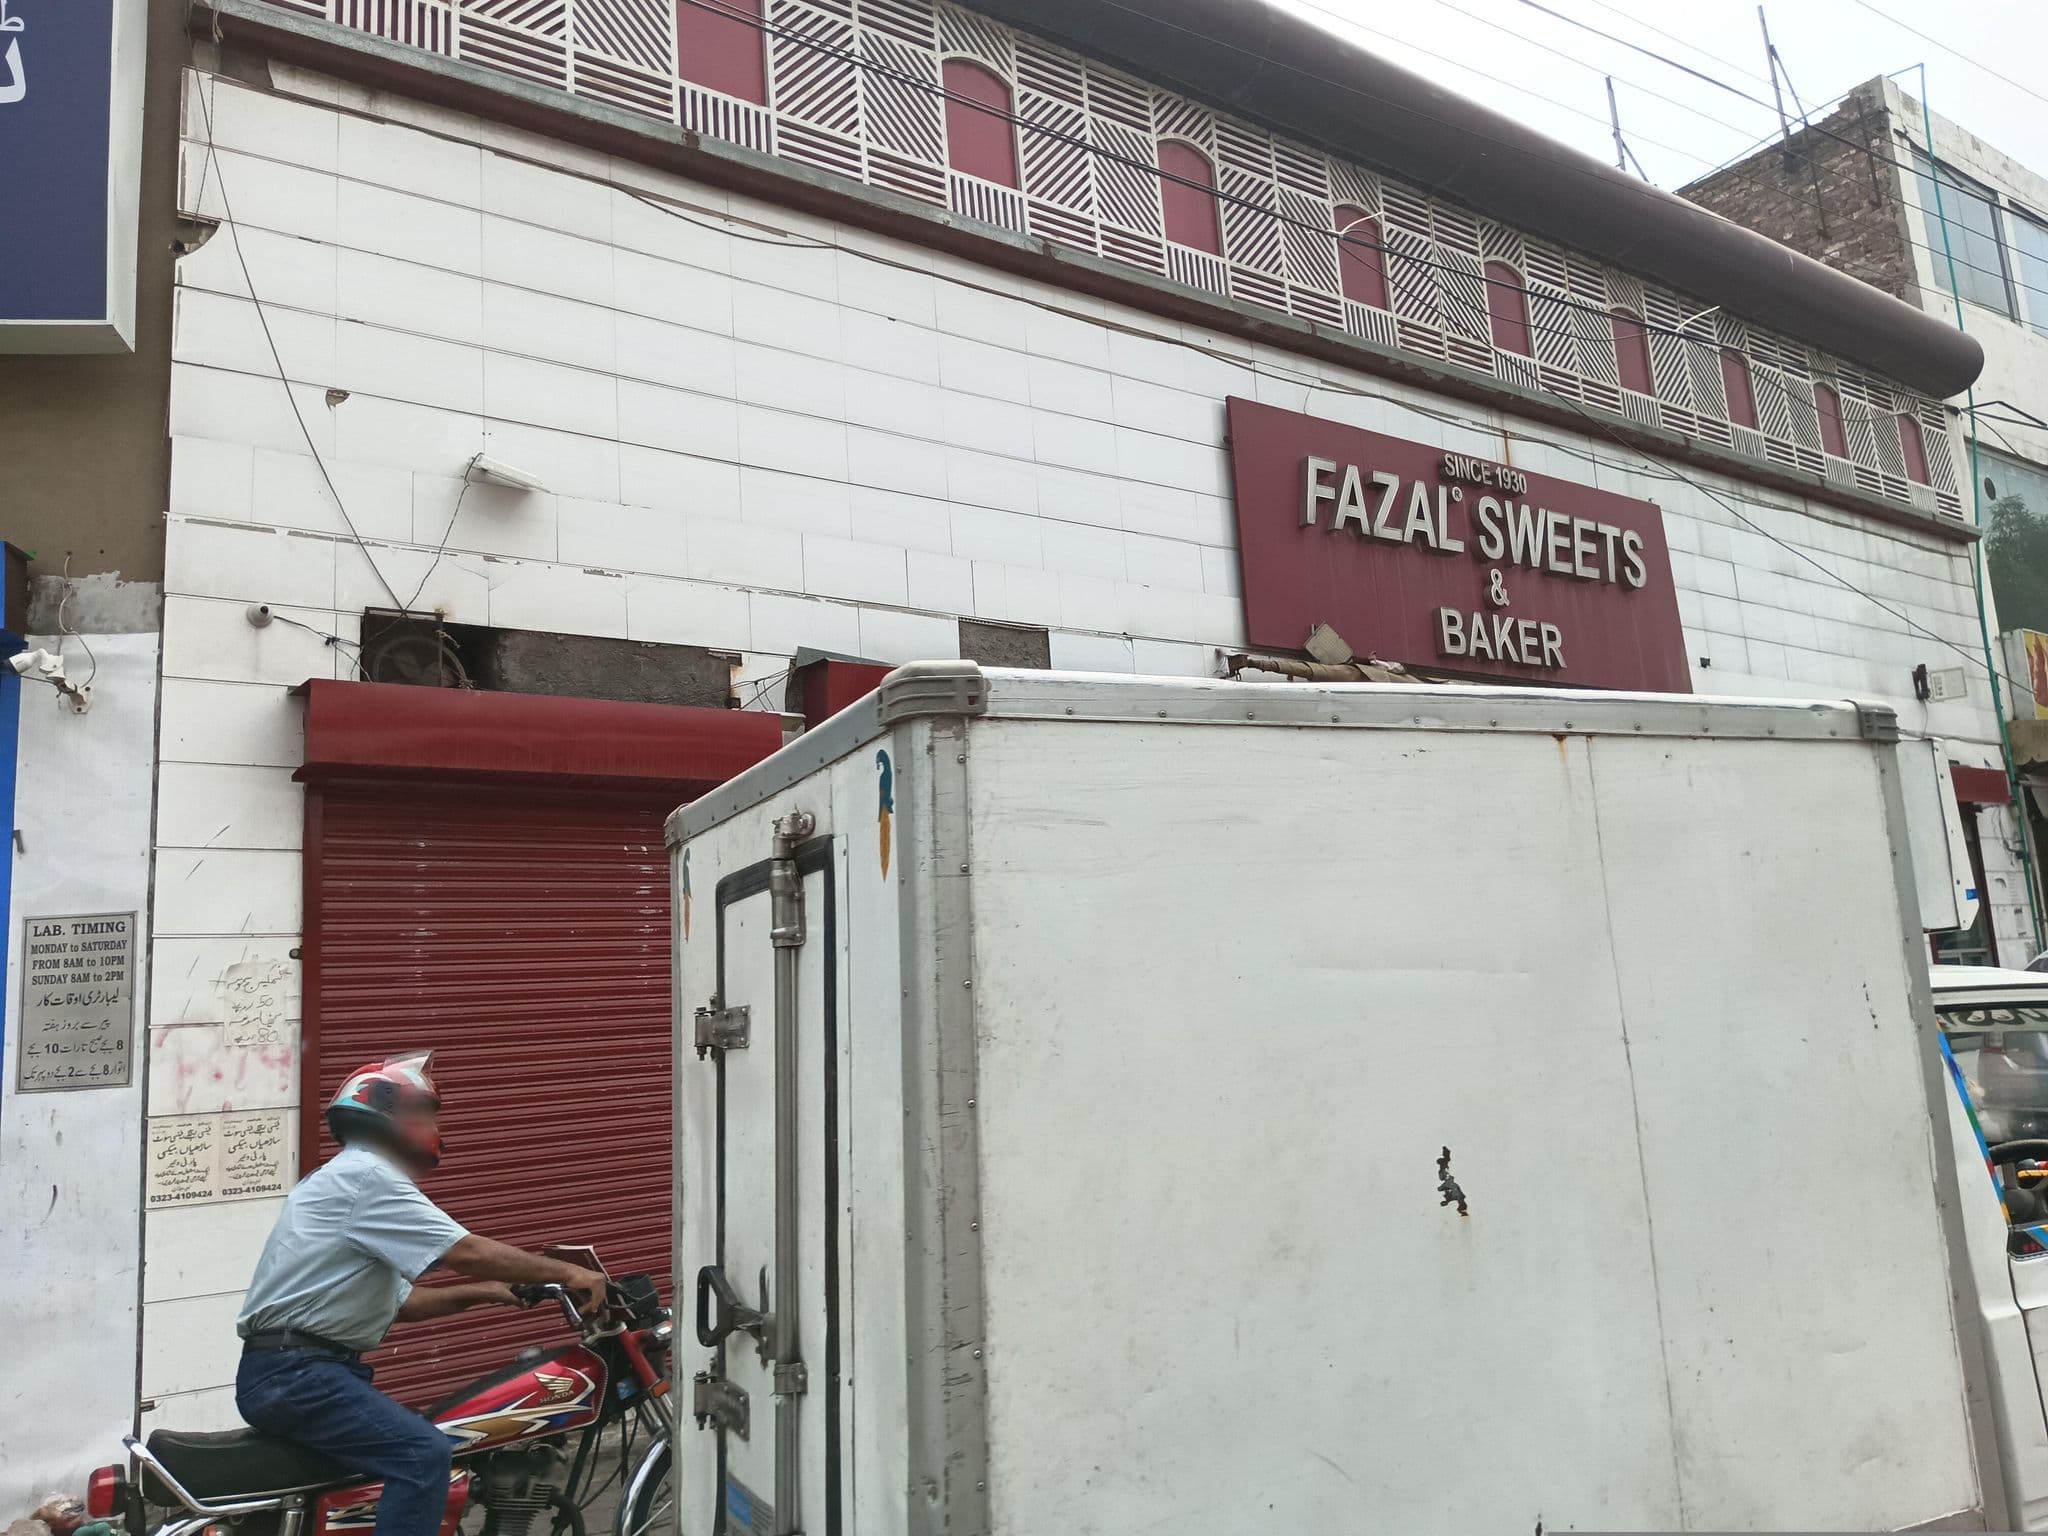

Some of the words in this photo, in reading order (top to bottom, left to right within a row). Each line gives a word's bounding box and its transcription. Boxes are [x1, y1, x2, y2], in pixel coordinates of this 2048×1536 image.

[1443, 453, 1493, 486] SINCE
[1495, 466, 1528, 495] 1930
[1300, 455, 1465, 555] FAZAL
[1475, 494, 1648, 590] SWEETS
[1487, 568, 1510, 607] &
[1436, 606, 1568, 670] BAKER
[33, 924, 66, 938] LAB.
[71, 921, 127, 936] TIMING
[30, 943, 68, 955] MONDAY
[70, 944, 79, 953] to
[80, 939, 128, 952] SATURDAY
[31, 958, 61, 970] FROM
[63, 957, 84, 968] 8AM
[86, 959, 96, 967] to
[100, 955, 125, 967] 10PM
[31, 973, 68, 986] SUNDAY
[70, 972, 91, 983] 8AM
[93, 974, 102, 982] to
[104, 970, 124, 982] 2PM
[258, 1028, 279, 1043] 80
[44, 1043, 59, 1054] 10
[116, 1039, 124, 1050] 8
[67, 1066, 75, 1078] 2
[103, 1064, 109, 1076] 8
